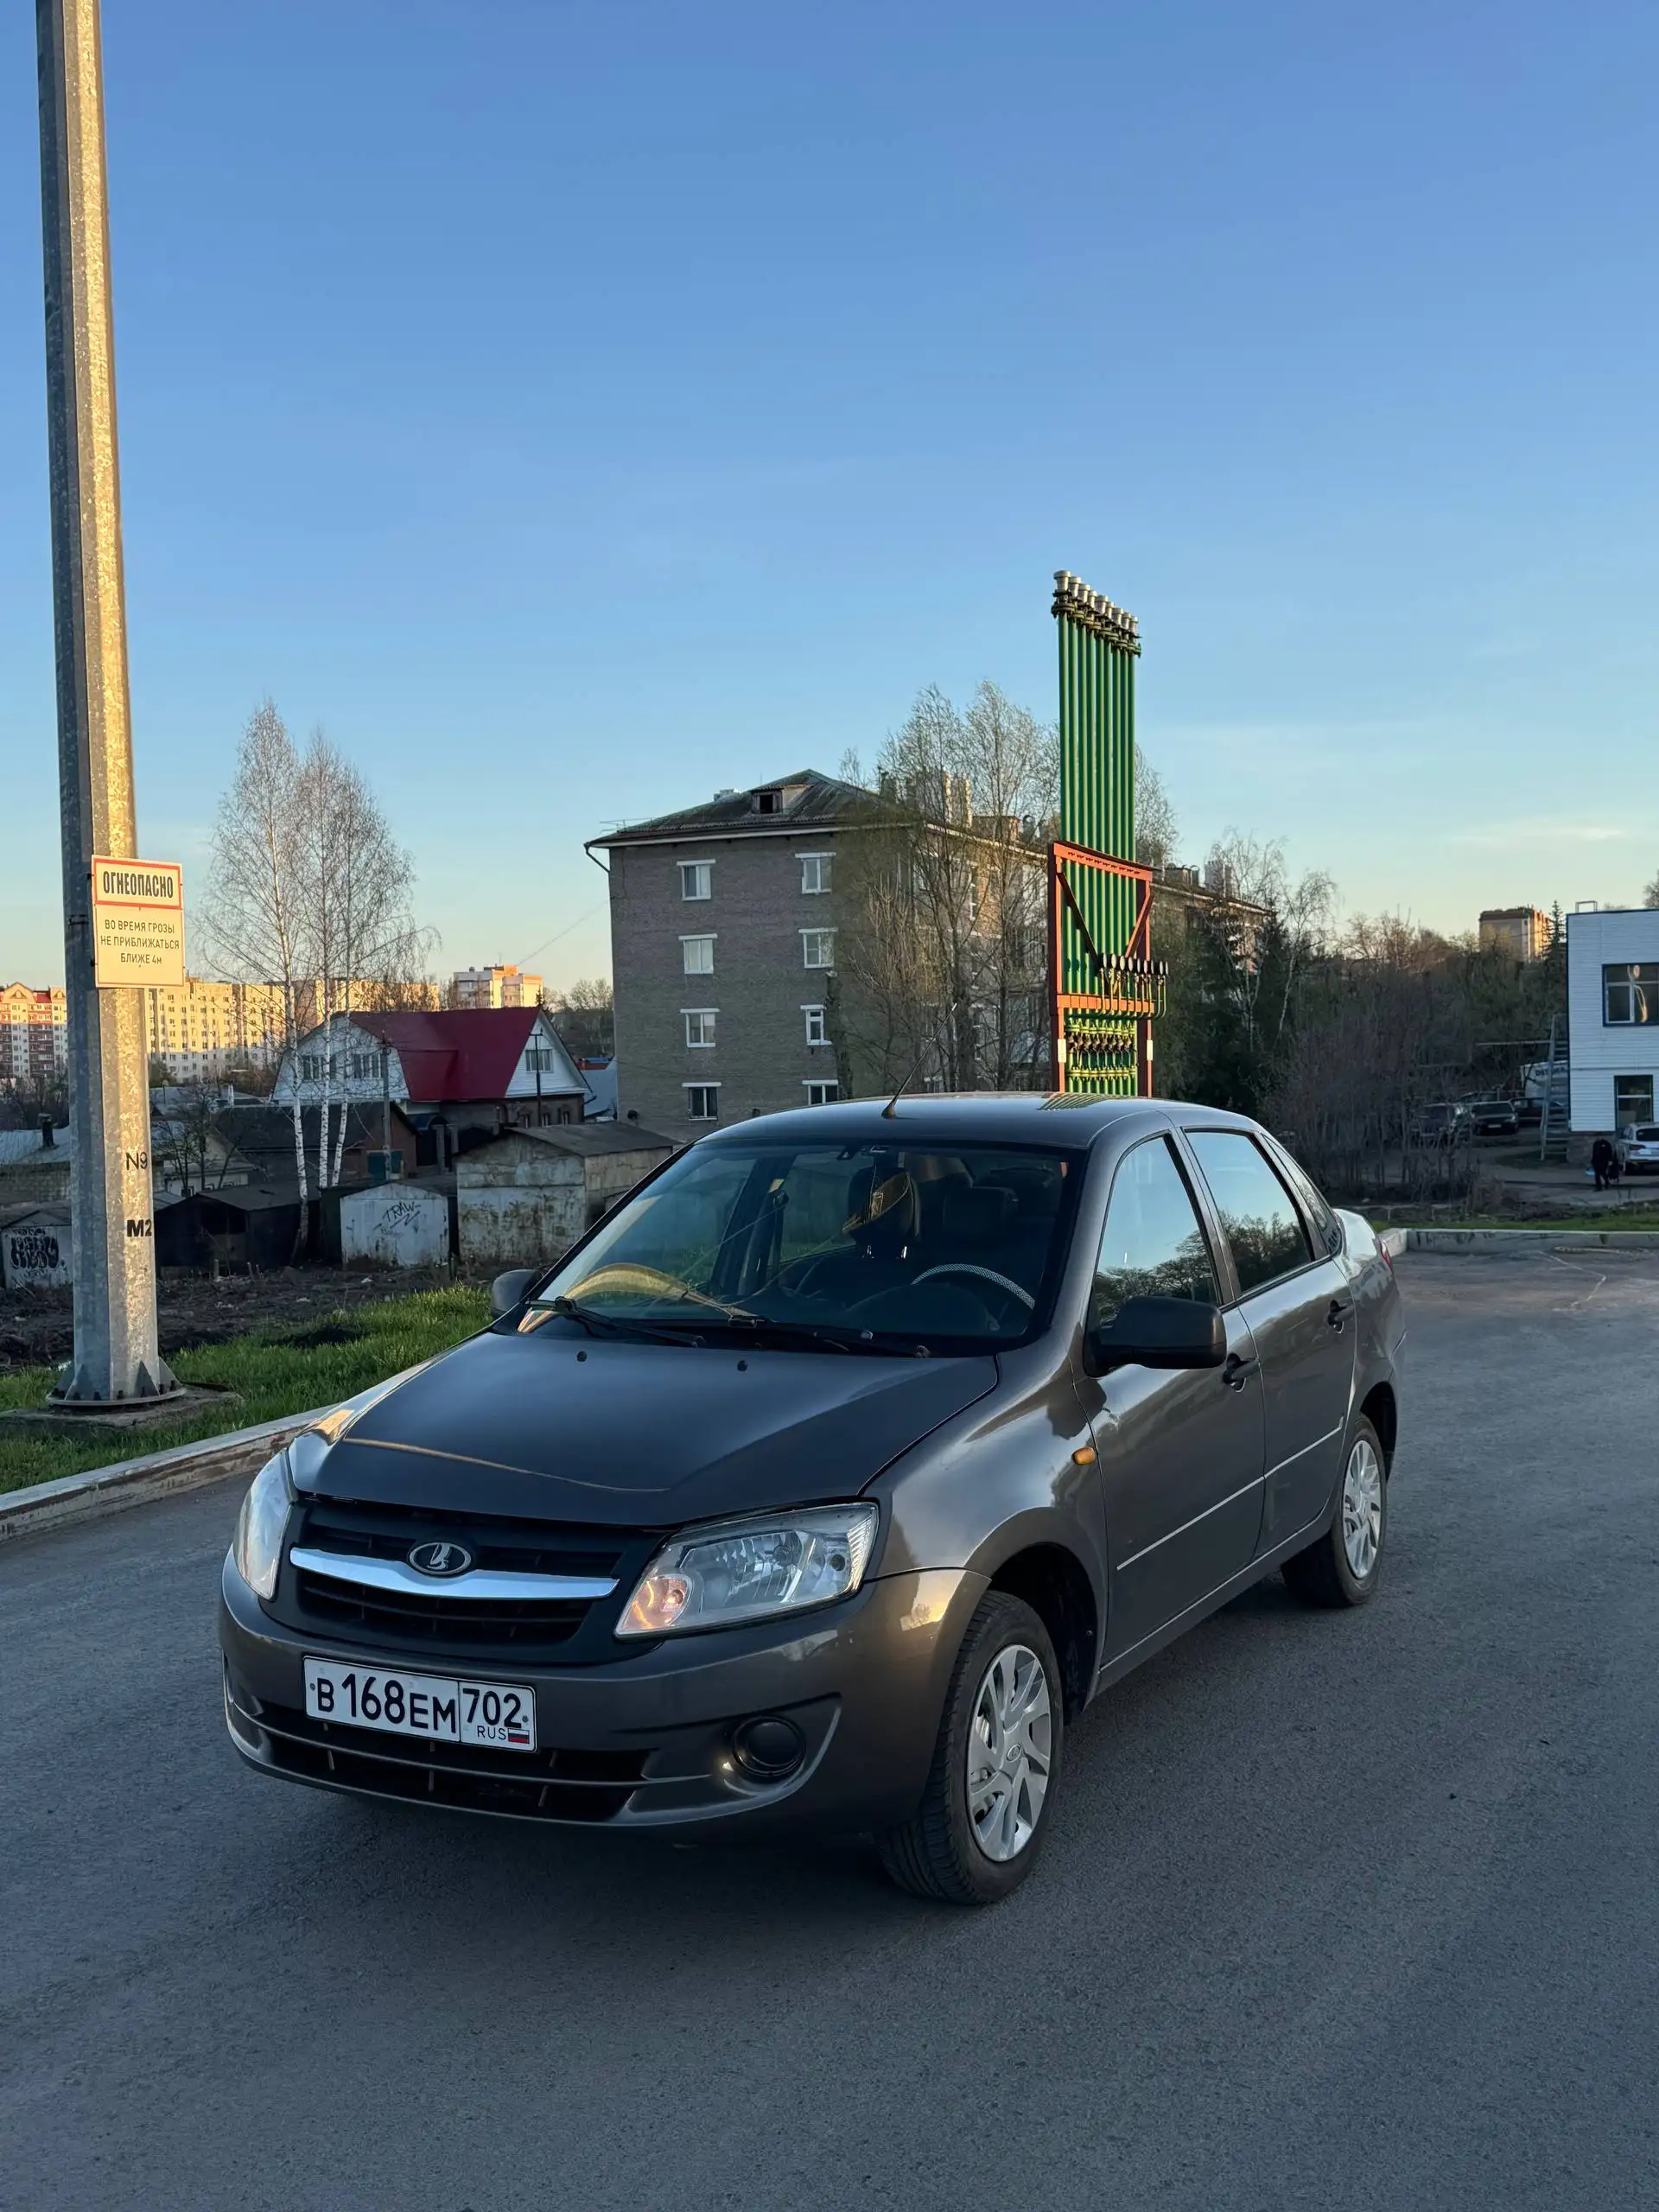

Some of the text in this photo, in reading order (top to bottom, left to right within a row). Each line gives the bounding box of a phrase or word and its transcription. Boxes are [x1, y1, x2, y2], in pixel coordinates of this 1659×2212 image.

[103, 870, 174, 899] ОГНЕОПАСНО
[105, 918, 175, 934] ВО ВРЕМЯ ГРОЗЫ
[100, 936, 180, 950] НЕ ПРИБЛИЖАТЬСЯ
[120, 952, 150, 963] БЛИЖЕ
[461, 1688, 523, 1729] 702
[476, 1724, 507, 1740] RUS
